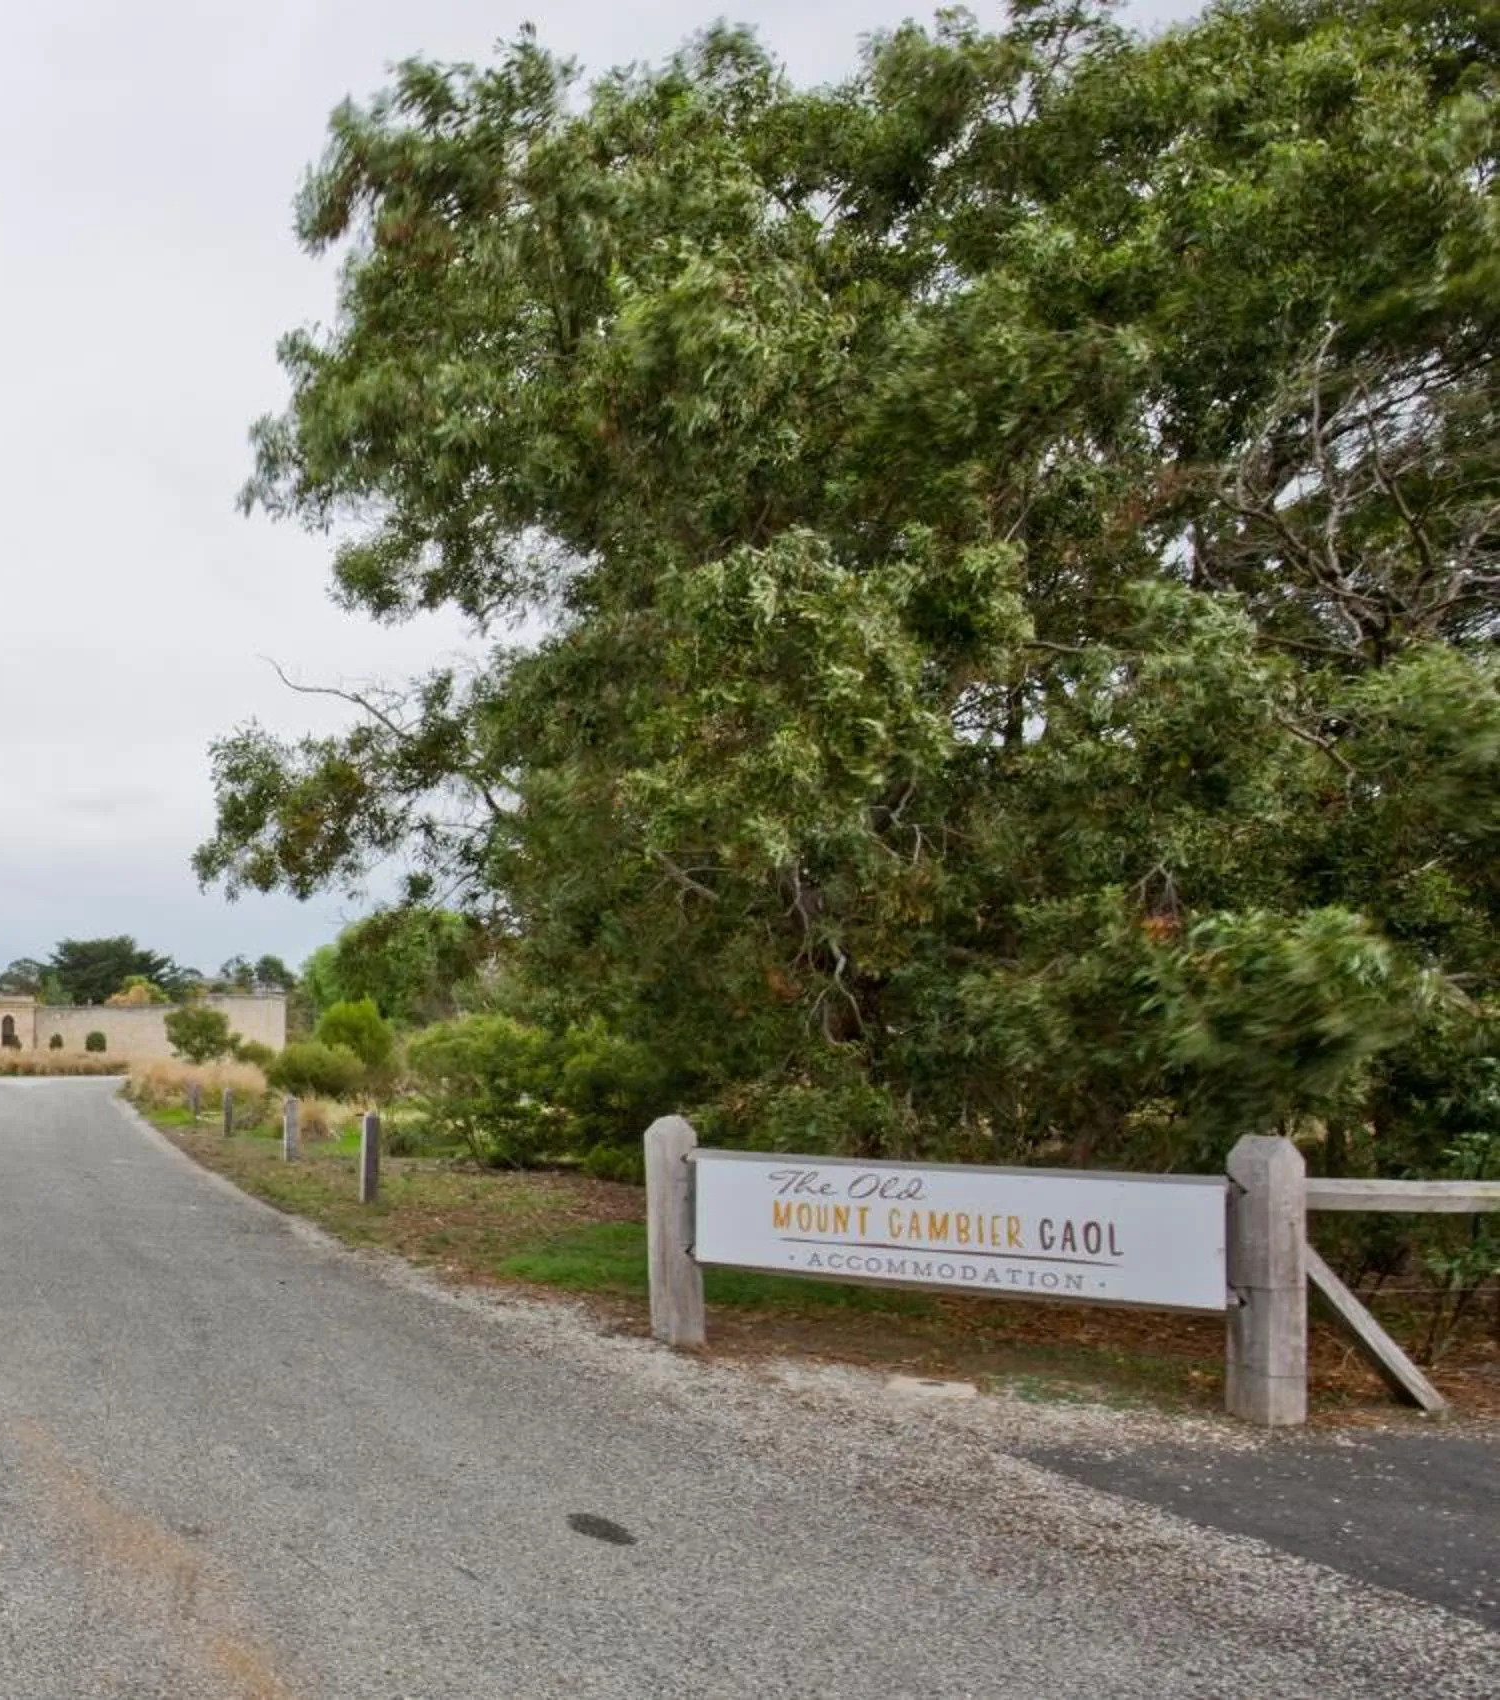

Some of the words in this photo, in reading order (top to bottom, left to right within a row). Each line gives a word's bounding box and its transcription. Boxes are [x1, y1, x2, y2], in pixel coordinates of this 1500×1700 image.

[768, 1170, 837, 1196] The
[847, 1172, 926, 1201] Old
[772, 1200, 870, 1236] MOUNT
[888, 1207, 1024, 1248] GAMBIER
[1039, 1219, 1125, 1256] GAOL
[807, 1252, 1084, 1290] ACCOMMODATION
